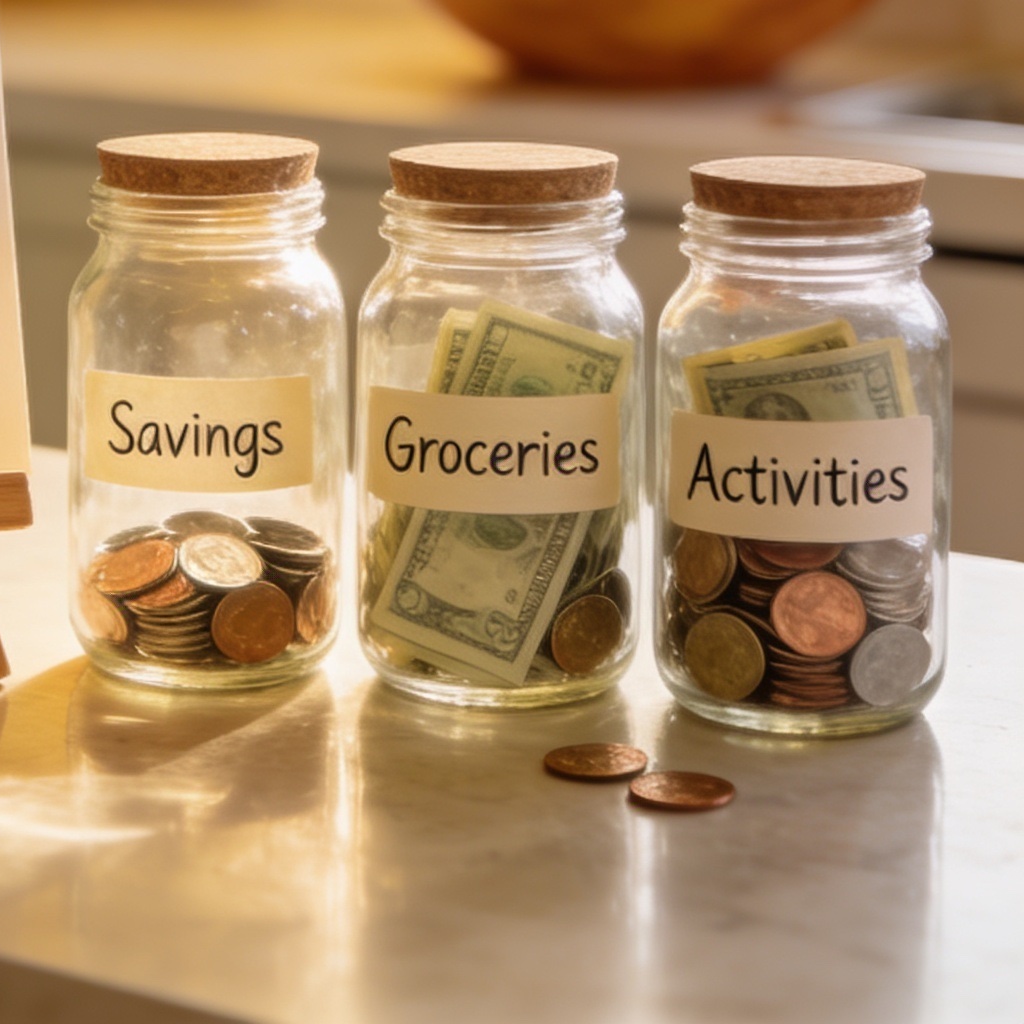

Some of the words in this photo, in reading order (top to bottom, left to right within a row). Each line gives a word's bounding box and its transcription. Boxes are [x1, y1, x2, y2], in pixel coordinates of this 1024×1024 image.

[108, 400, 284, 477] Savings
[385, 415, 599, 477] Groceries
[687, 444, 909, 508] Activities
